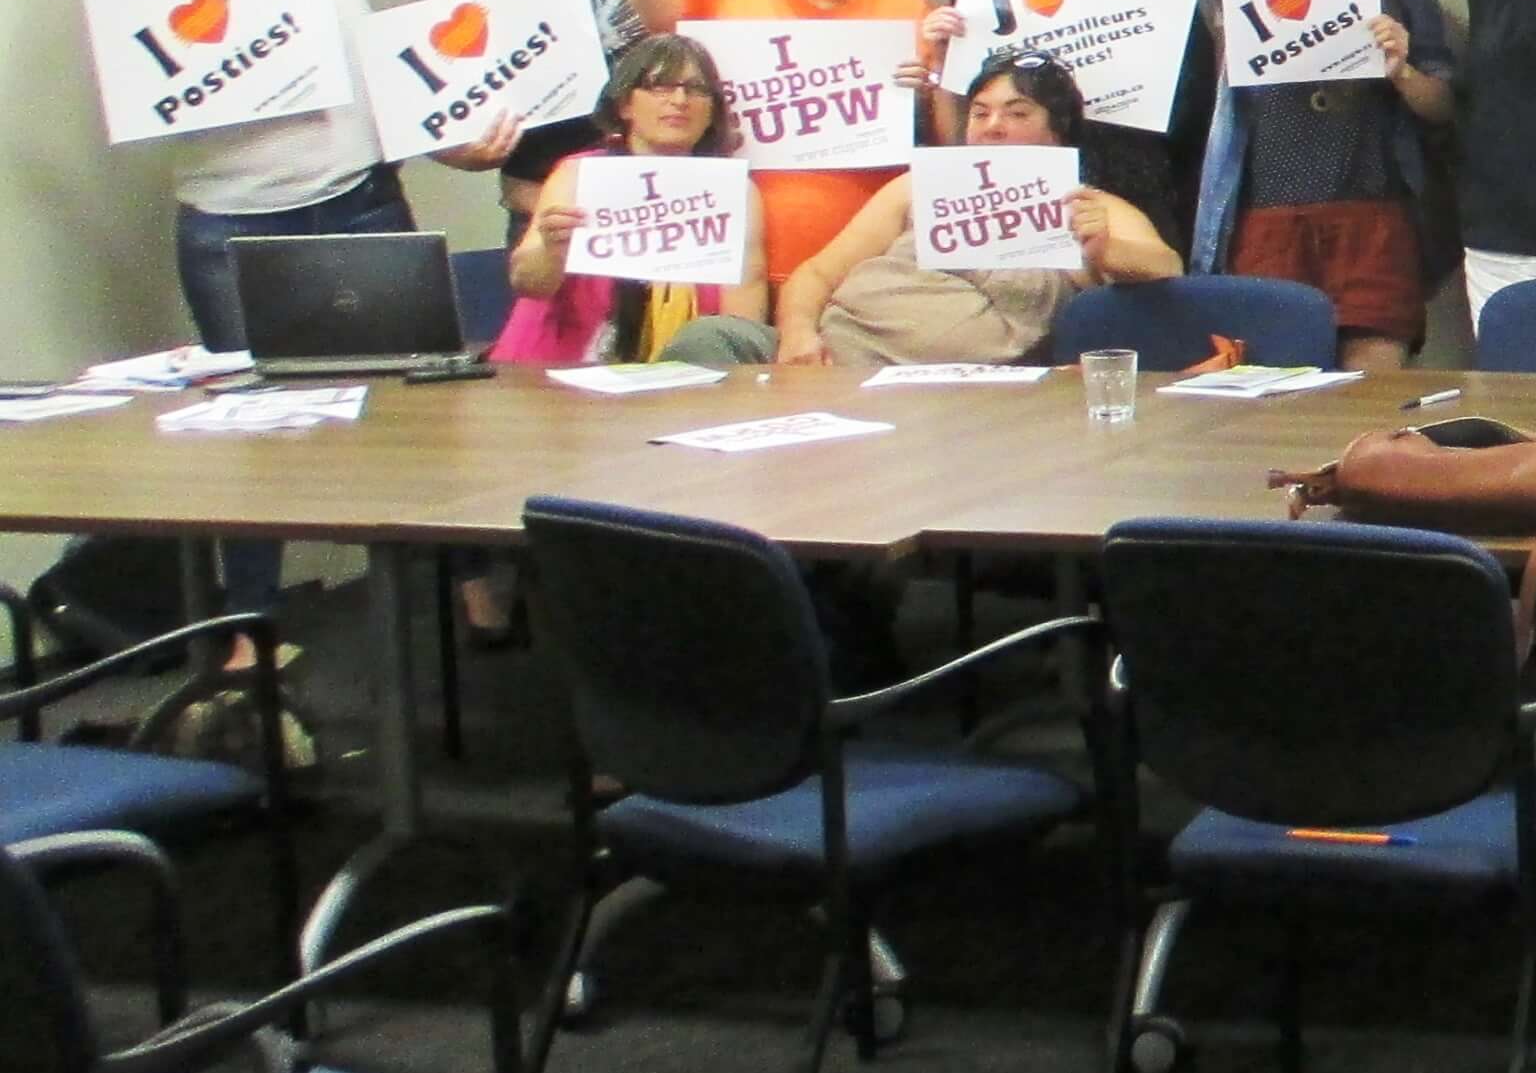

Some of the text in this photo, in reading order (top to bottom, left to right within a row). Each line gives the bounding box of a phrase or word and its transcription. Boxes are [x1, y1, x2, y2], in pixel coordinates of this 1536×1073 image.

[1023, 5, 1147, 50] travailleurs
[1240, 1, 1274, 43] I
[1248, 2, 1363, 76] Posties!
[133, 27, 184, 77] I
[154, 12, 300, 124] Posties!
[398, 47, 447, 94] I
[770, 35, 798, 71] I
[1064, 48, 1113, 71] stes!
[422, 21, 558, 140] Posties!
[721, 56, 864, 104] Support
[731, 83, 883, 150] UPW
[640, 171, 661, 201] I
[933, 177, 1050, 218] Support
[973, 160, 995, 190] I
[596, 190, 716, 228] Support
[929, 199, 1063, 253] CUPW
[587, 213, 731, 258] CUPW
